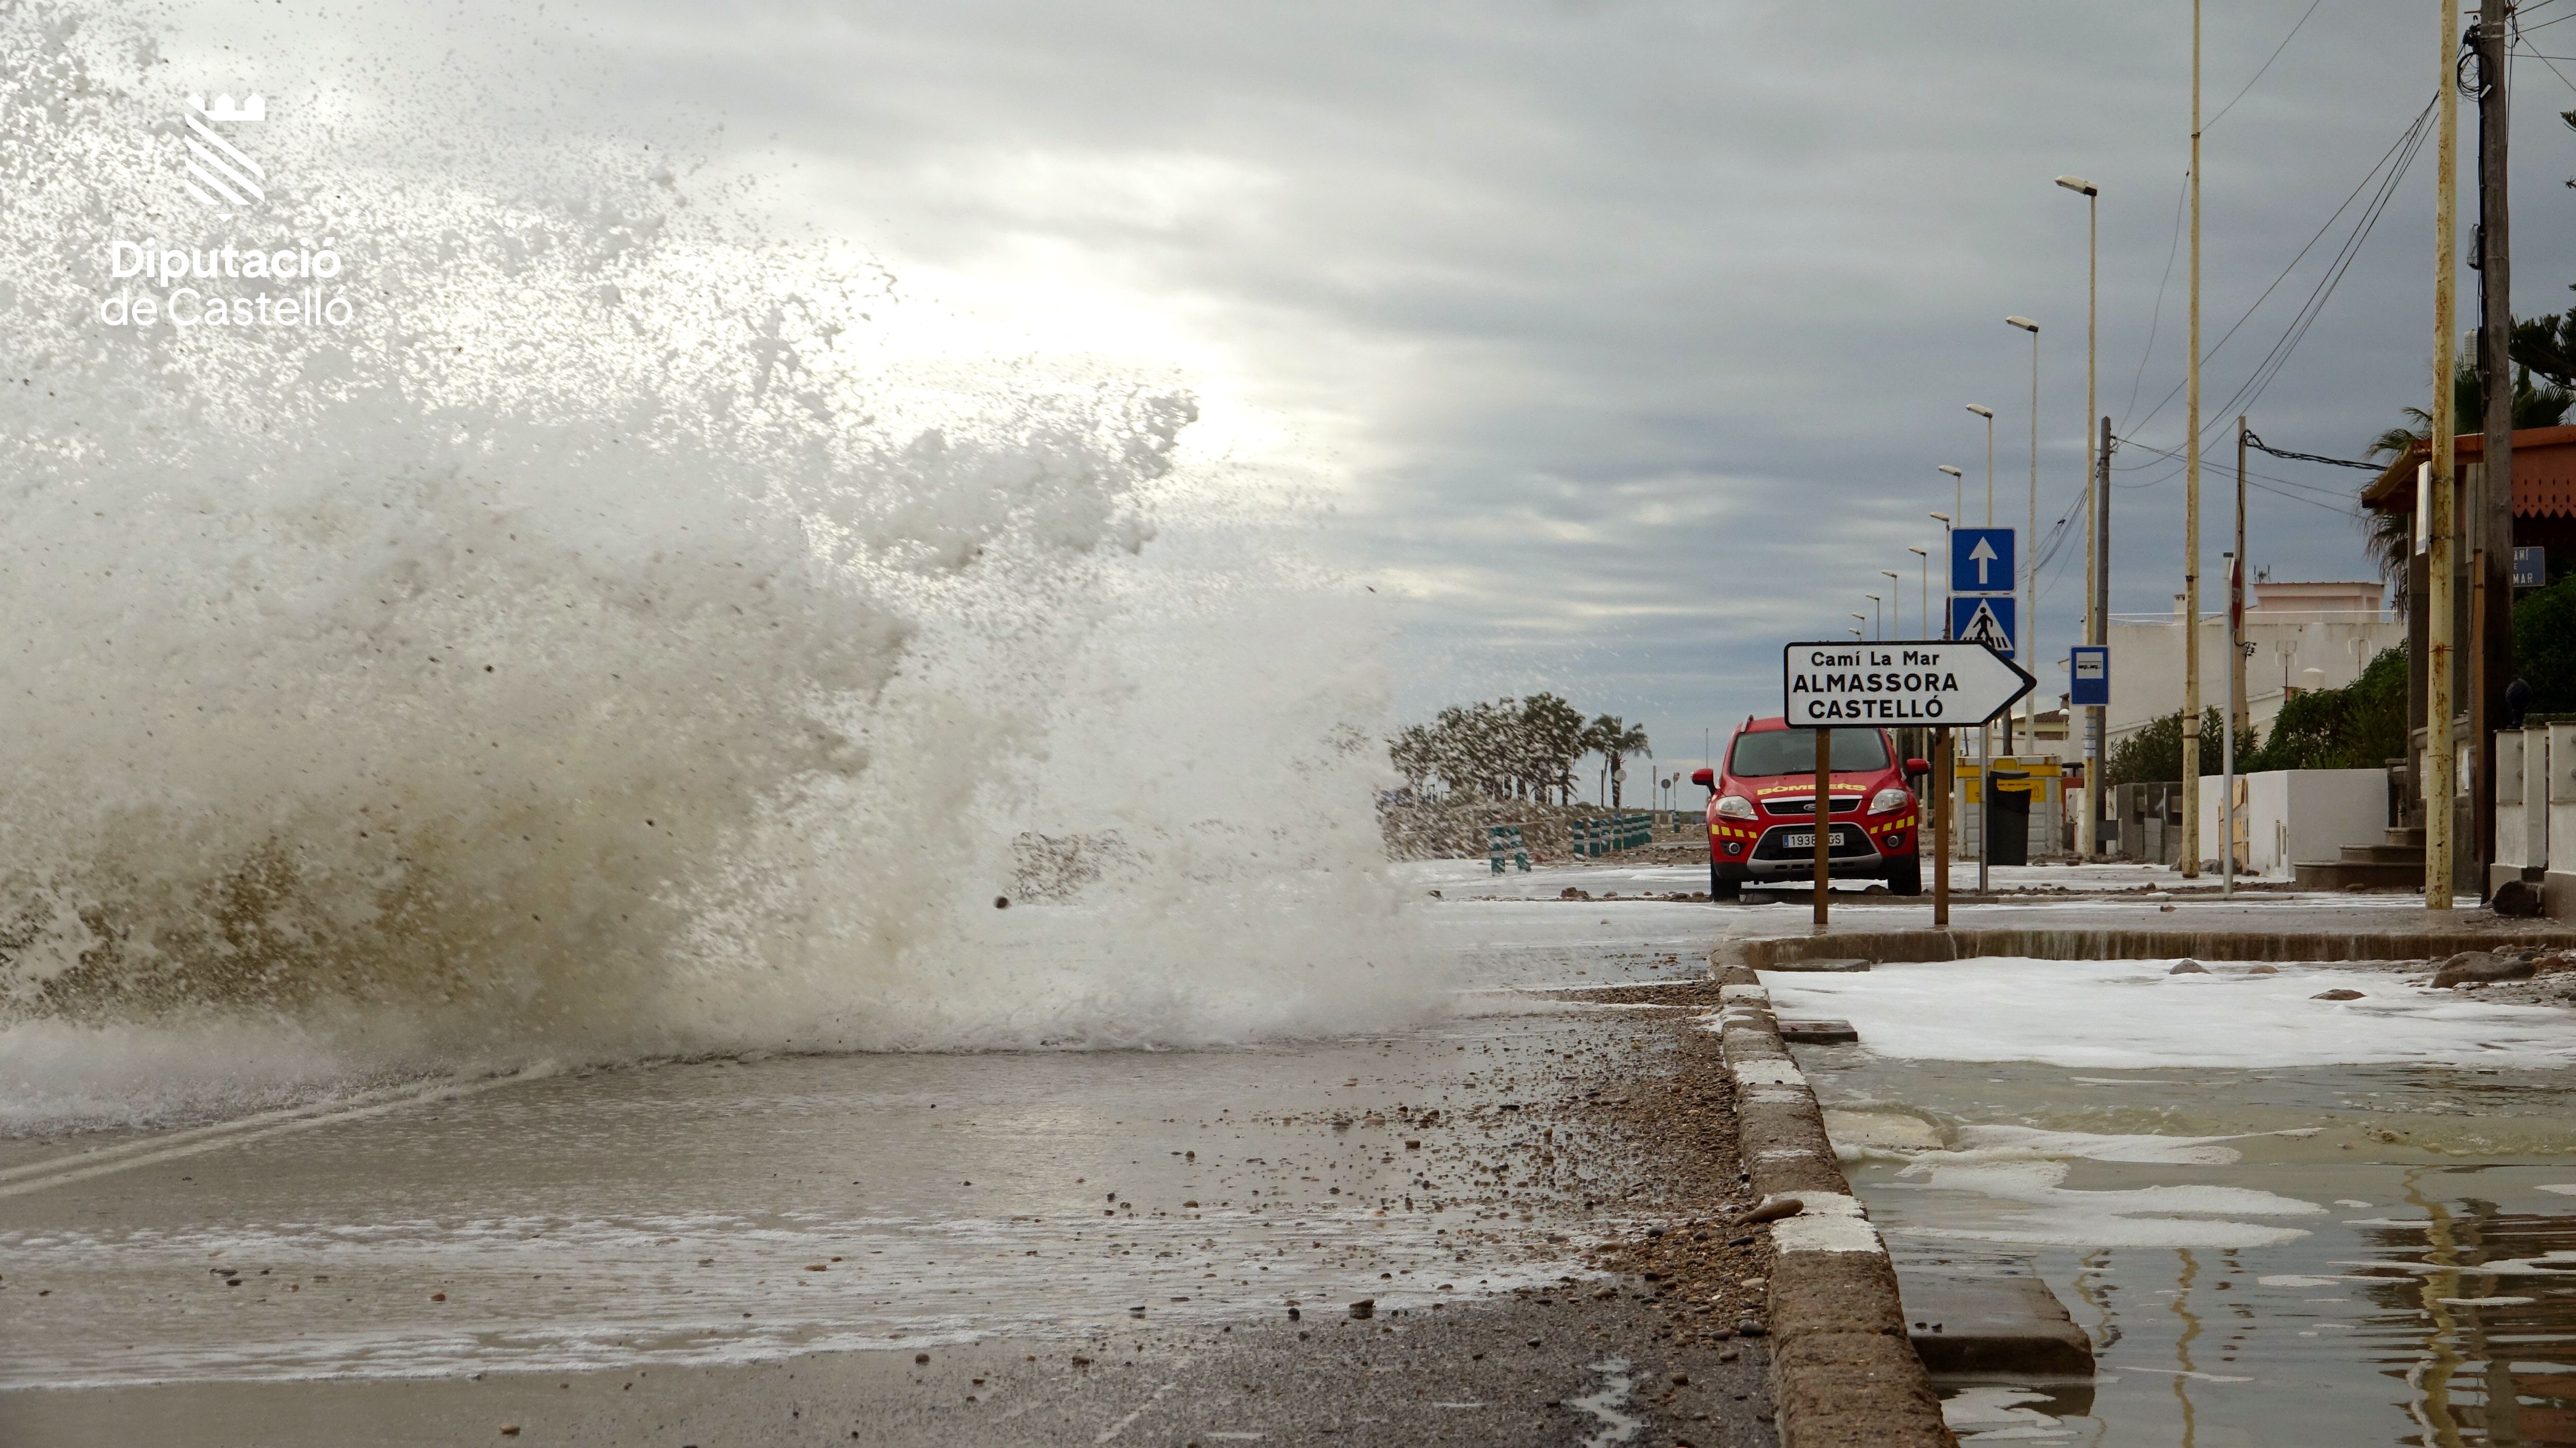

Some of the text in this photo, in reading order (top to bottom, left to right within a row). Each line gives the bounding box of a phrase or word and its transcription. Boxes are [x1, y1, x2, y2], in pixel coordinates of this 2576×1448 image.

[1811, 651, 1940, 667] Camí La Mar
[1793, 673, 1959, 693] ALMASSORA
[1808, 695, 1943, 719] CASTELLÓ
